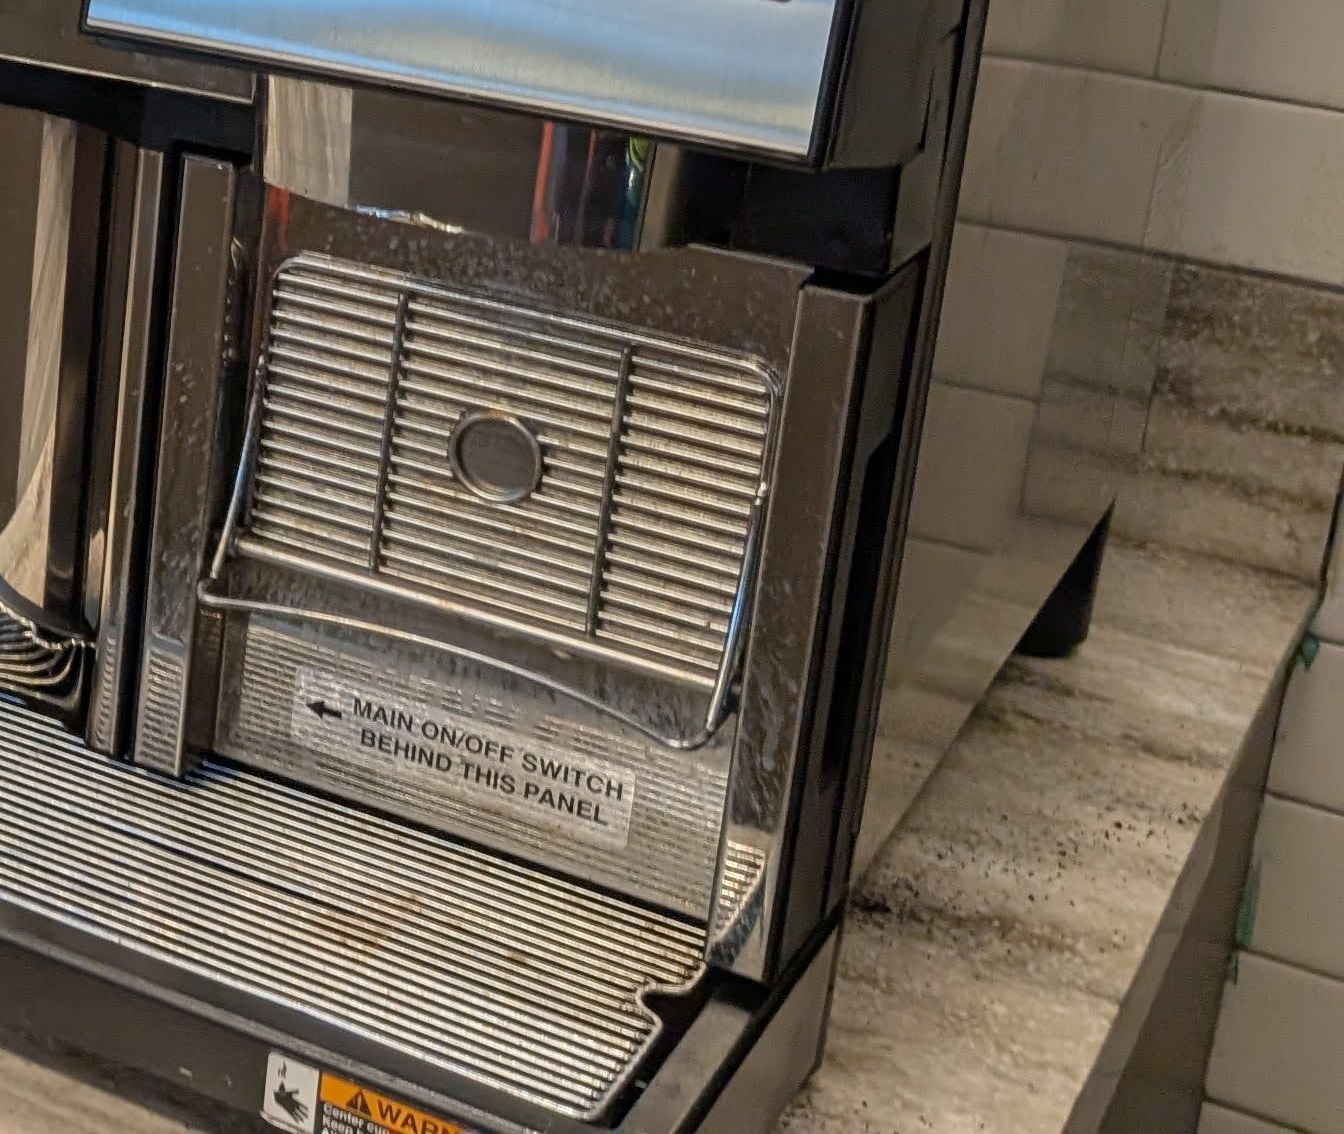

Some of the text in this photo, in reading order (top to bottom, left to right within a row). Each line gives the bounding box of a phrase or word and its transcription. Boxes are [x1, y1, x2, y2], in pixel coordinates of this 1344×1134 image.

[353, 698, 624, 801] MAIN ON/OFF SWITCH
[361, 728, 609, 826] BEHIND THIS PANEL
